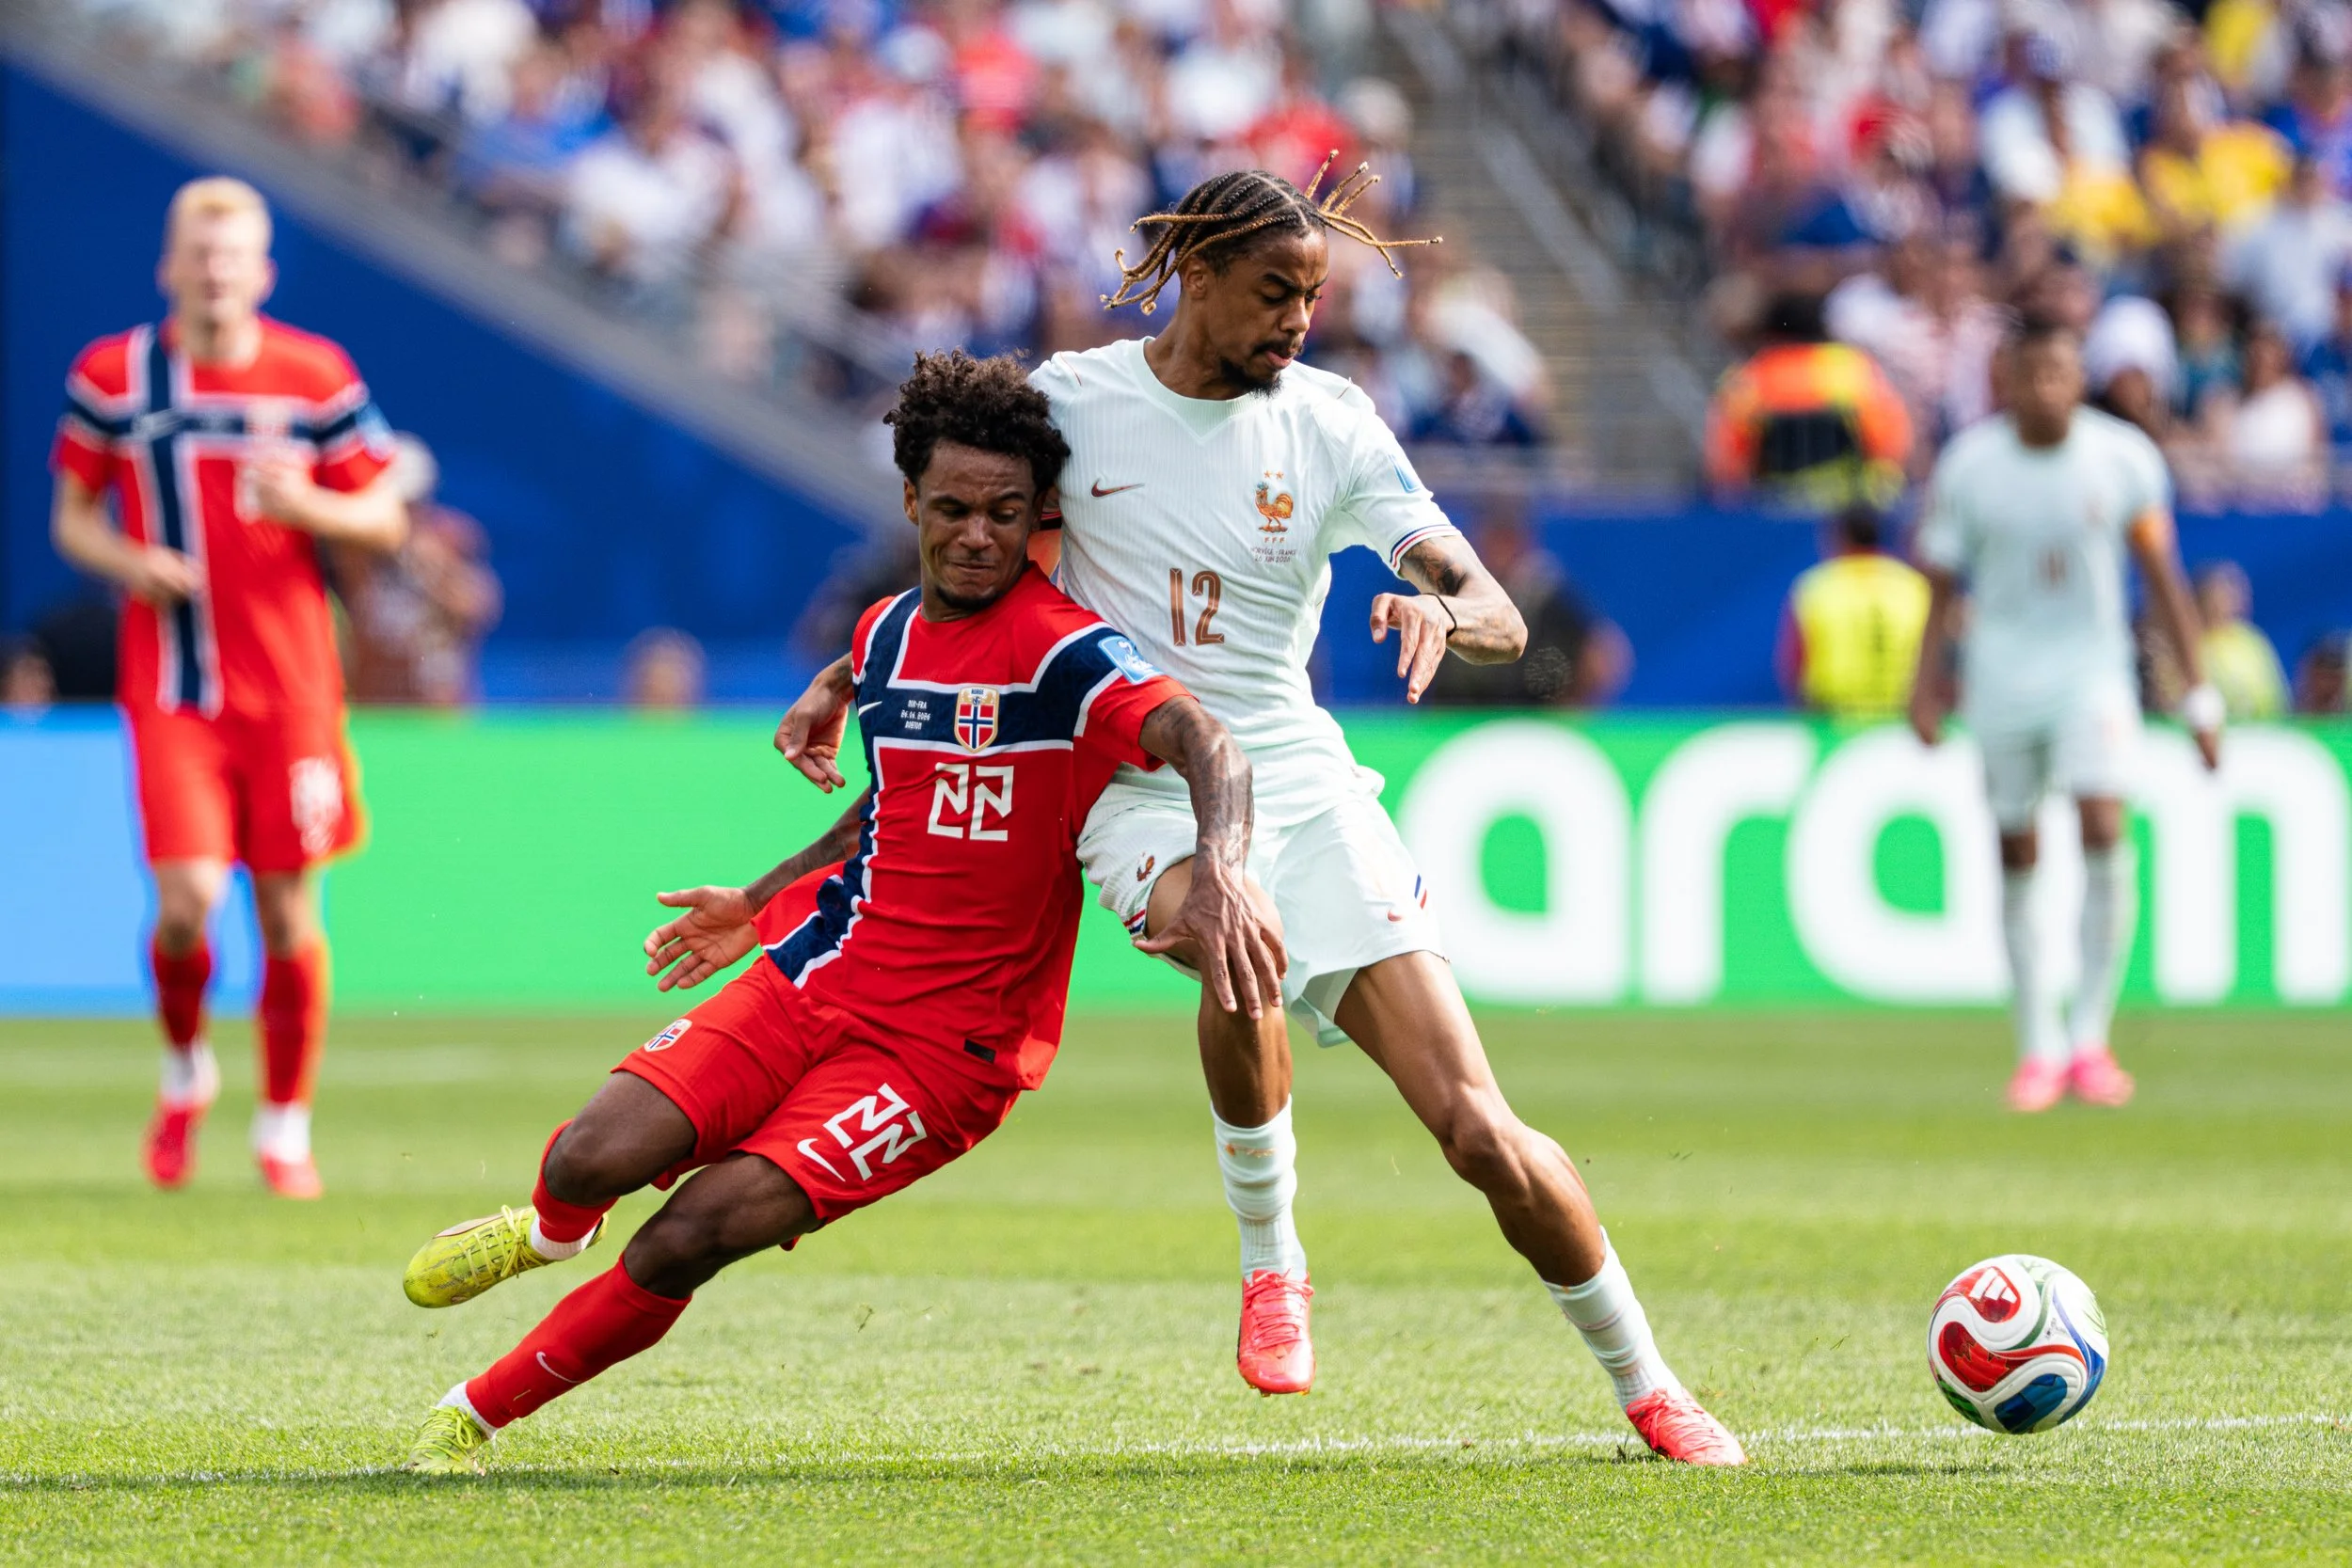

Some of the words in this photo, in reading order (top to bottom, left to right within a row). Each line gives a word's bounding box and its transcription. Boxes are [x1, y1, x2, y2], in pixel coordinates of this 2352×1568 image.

[1169, 567, 1225, 646] 12
[927, 761, 1014, 842] 22
[822, 1082, 928, 1182] 22
